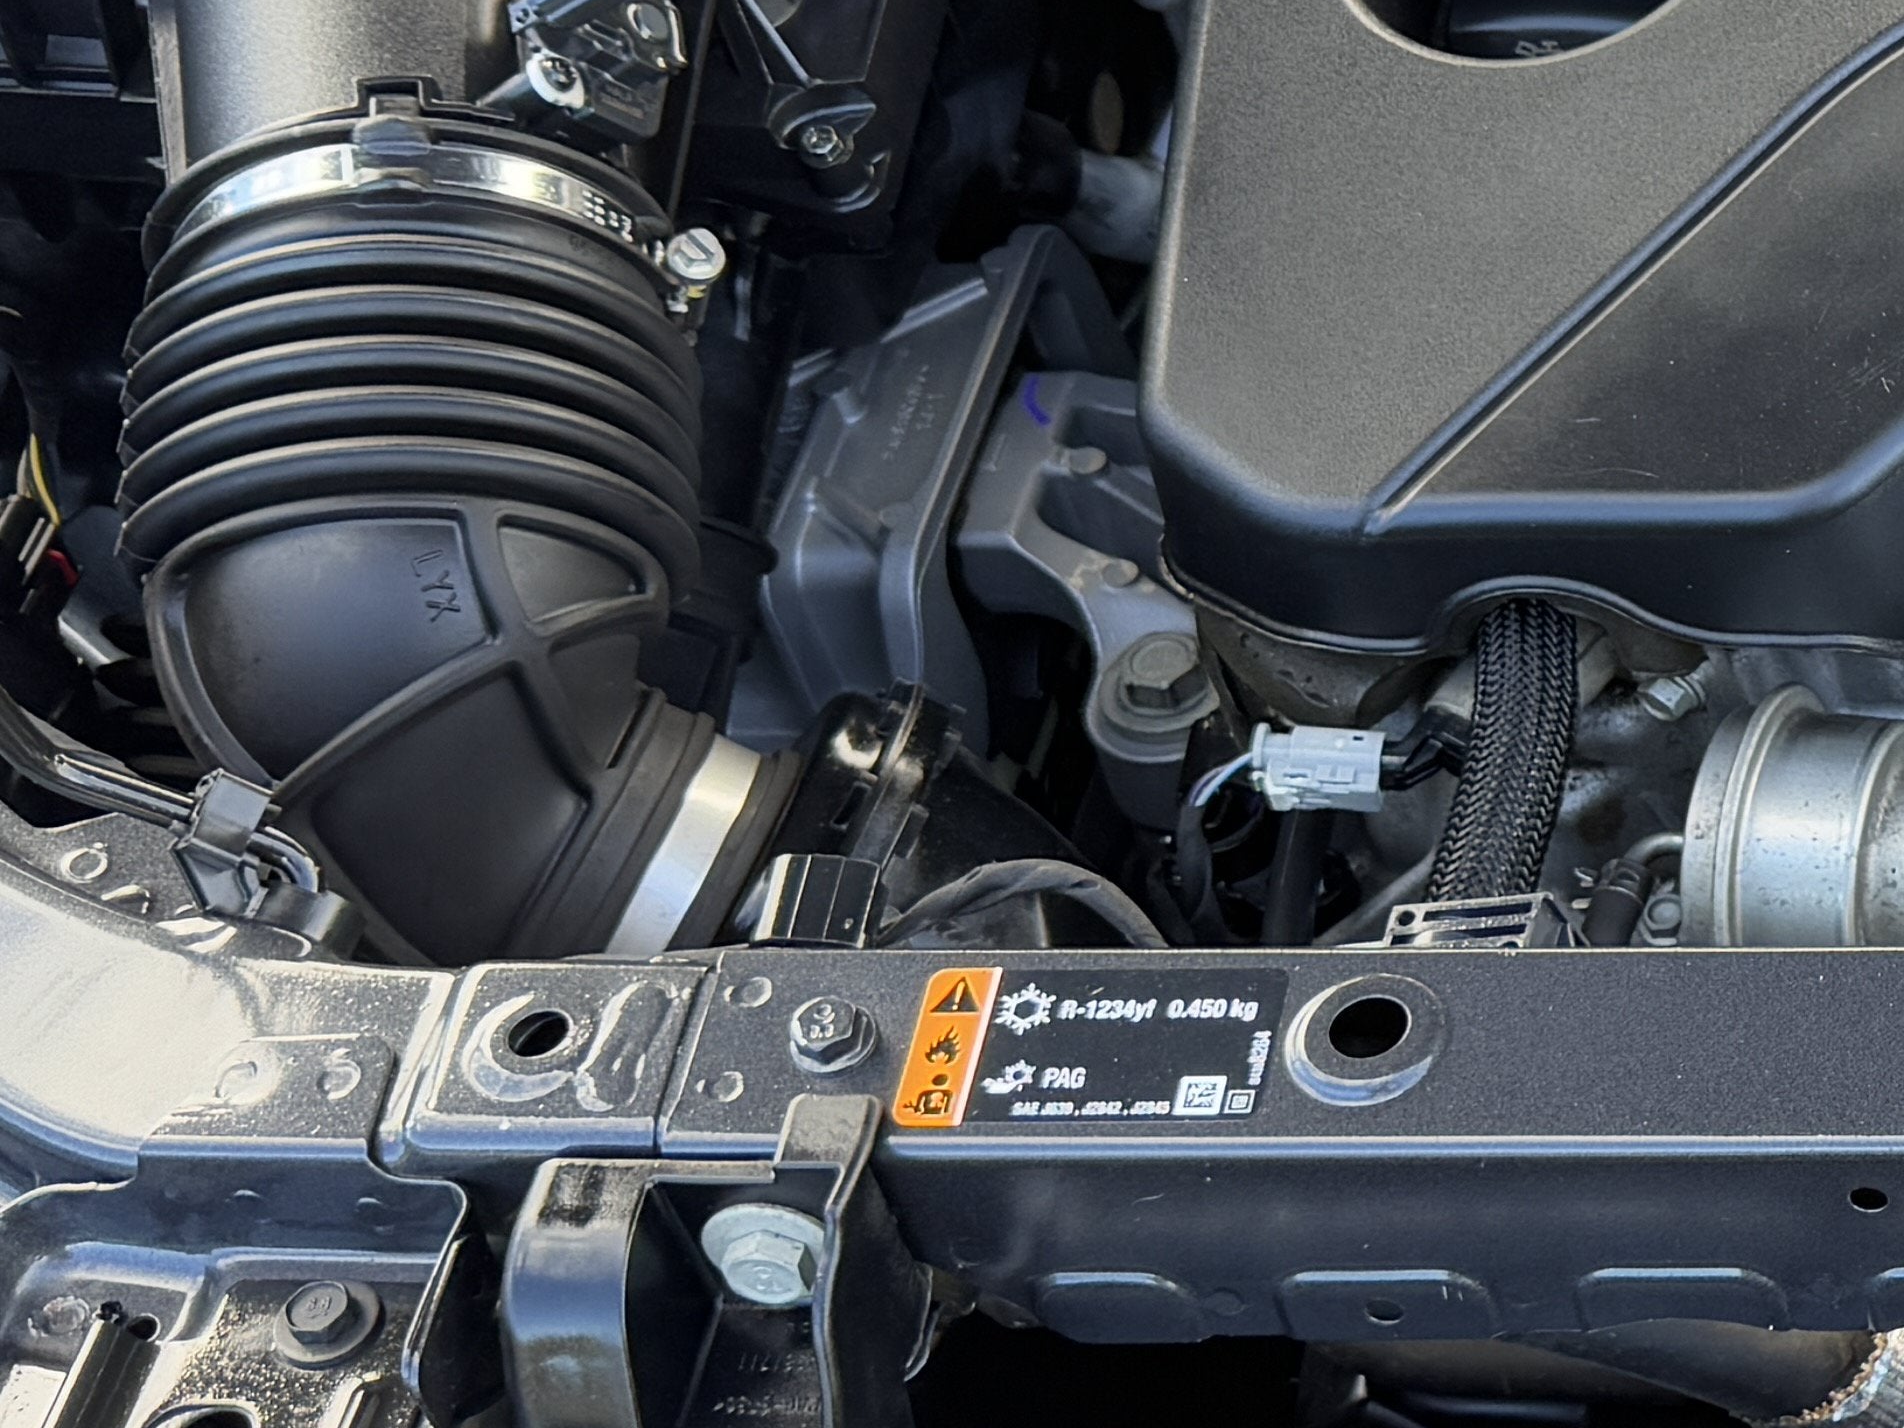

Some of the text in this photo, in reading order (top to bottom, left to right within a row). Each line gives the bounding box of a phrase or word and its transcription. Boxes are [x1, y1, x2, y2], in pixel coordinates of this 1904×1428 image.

[1056, 997, 1260, 1023] R-1234yf 0.450 kg
[1040, 1067, 1087, 1090] PAG
